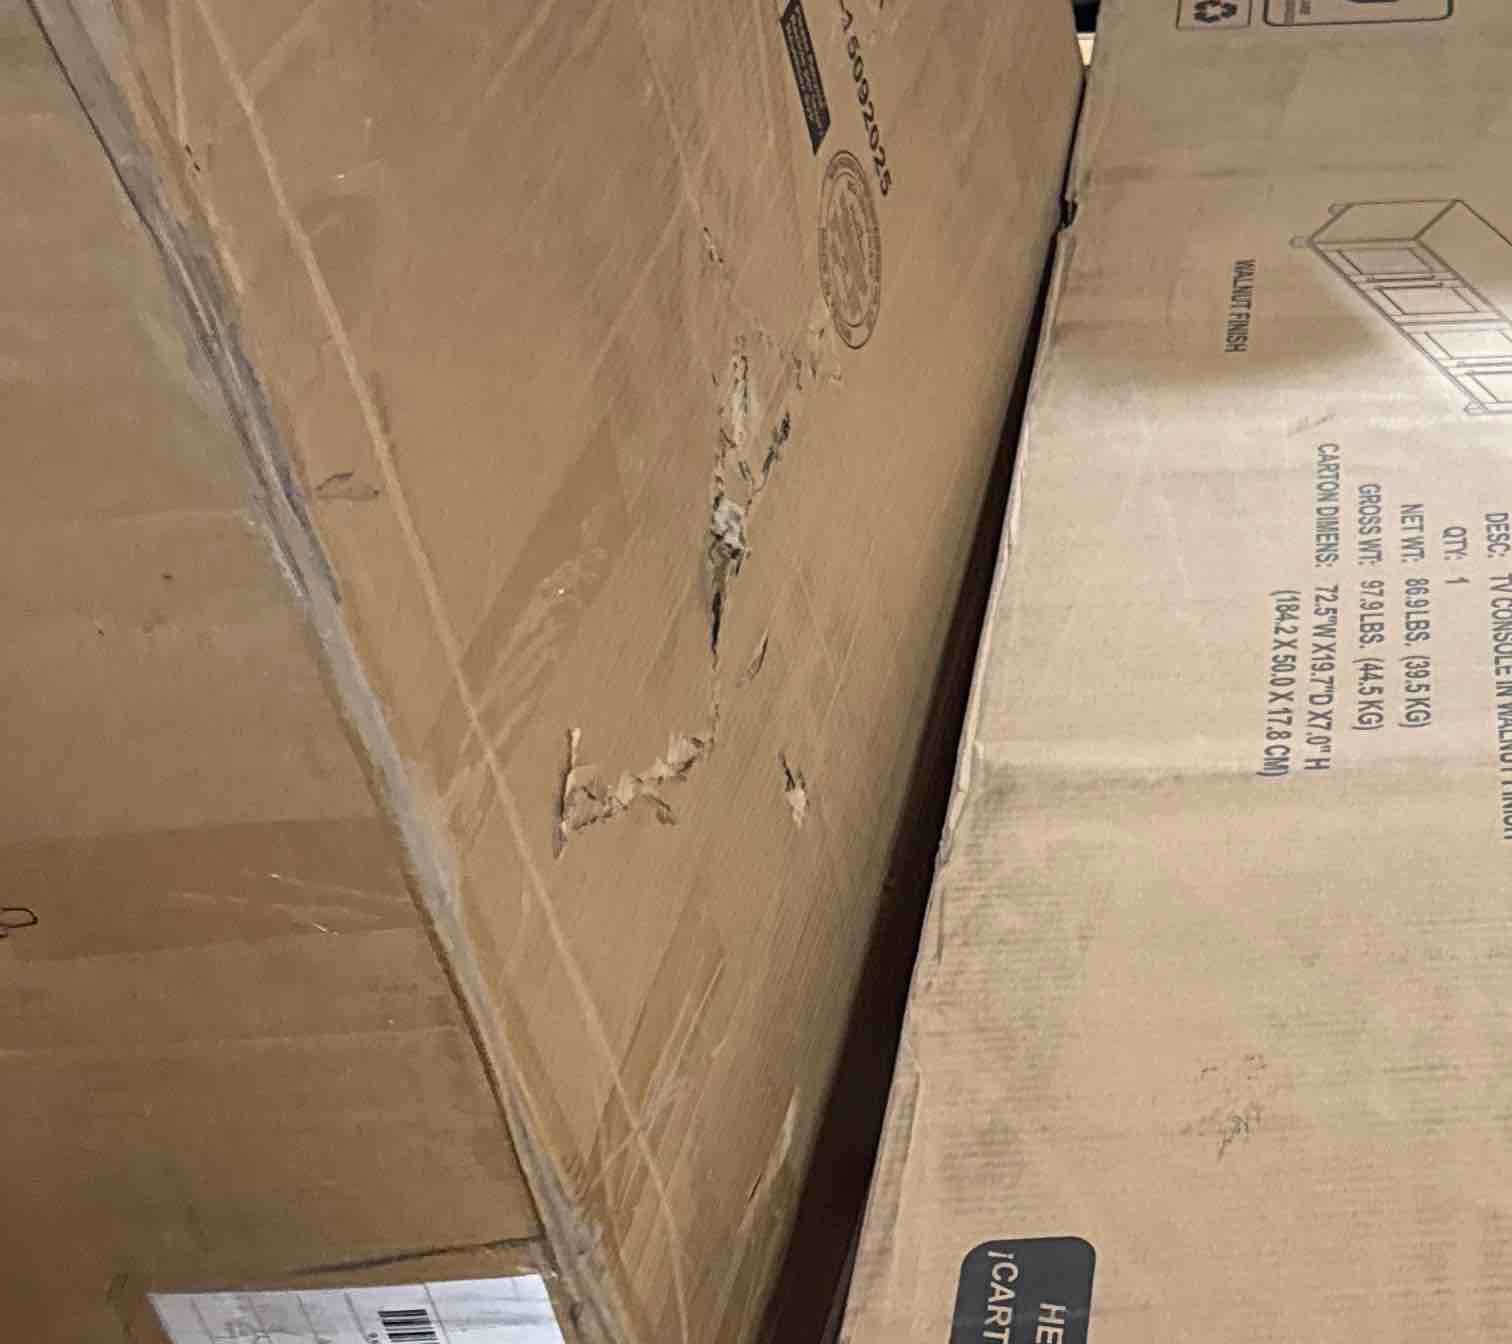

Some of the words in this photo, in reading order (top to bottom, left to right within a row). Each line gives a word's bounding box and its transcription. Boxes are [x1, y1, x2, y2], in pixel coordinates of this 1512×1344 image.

[1230, 259, 1256, 310] WALNUT
[1224, 312, 1251, 353] FINISH
[1317, 443, 1340, 503] CARTON
[1358, 483, 1382, 535] GROSS
[1401, 504, 1424, 533] NET
[1314, 506, 1340, 568] DIMENS:
[1358, 536, 1382, 566] WT:
[1401, 535, 1425, 564] WT:
[1441, 526, 1467, 561] QTY:
[1485, 512, 1511, 558] DESC:
[1445, 576, 1470, 584] 1
[1269, 590, 1302, 635] (184.2
[1272, 638, 1298, 650] X
[1270, 654, 1297, 687] 50.0
[1352, 657, 1384, 696] (44.5
[1399, 655, 1431, 694] (39.5
[1268, 690, 1295, 703] X
[1398, 697, 1431, 728] KG)
[1266, 707, 1293, 741] 17.8
[1352, 699, 1384, 731] KG)
[1256, 744, 1291, 777] CM)
[1304, 758, 1331, 770] H
